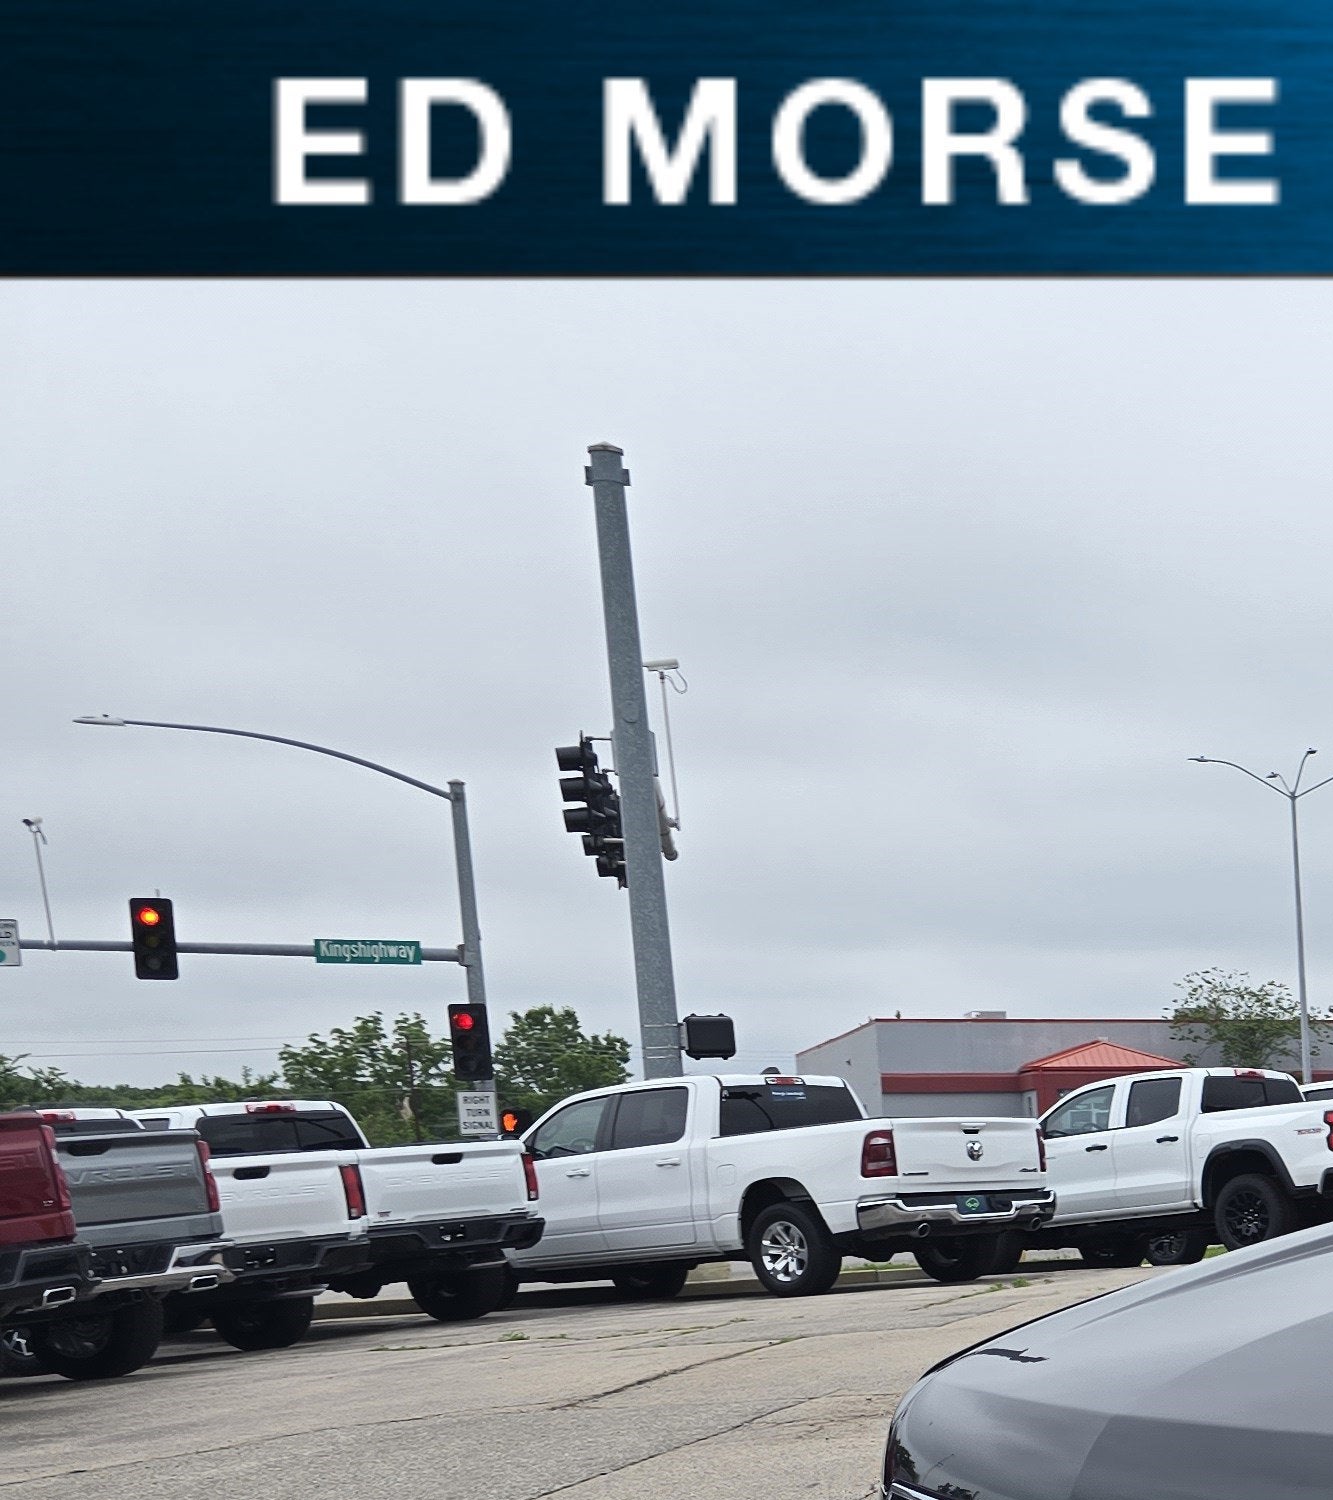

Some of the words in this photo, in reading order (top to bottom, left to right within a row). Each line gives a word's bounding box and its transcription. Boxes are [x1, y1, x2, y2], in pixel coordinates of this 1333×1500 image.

[320, 941, 416, 963] Kingshighway
[463, 1095, 490, 1104] RIGHT
[466, 1108, 491, 1117] TURN
[462, 1121, 496, 1130] SIGNAL
[66, 1162, 194, 1185] VROLET
